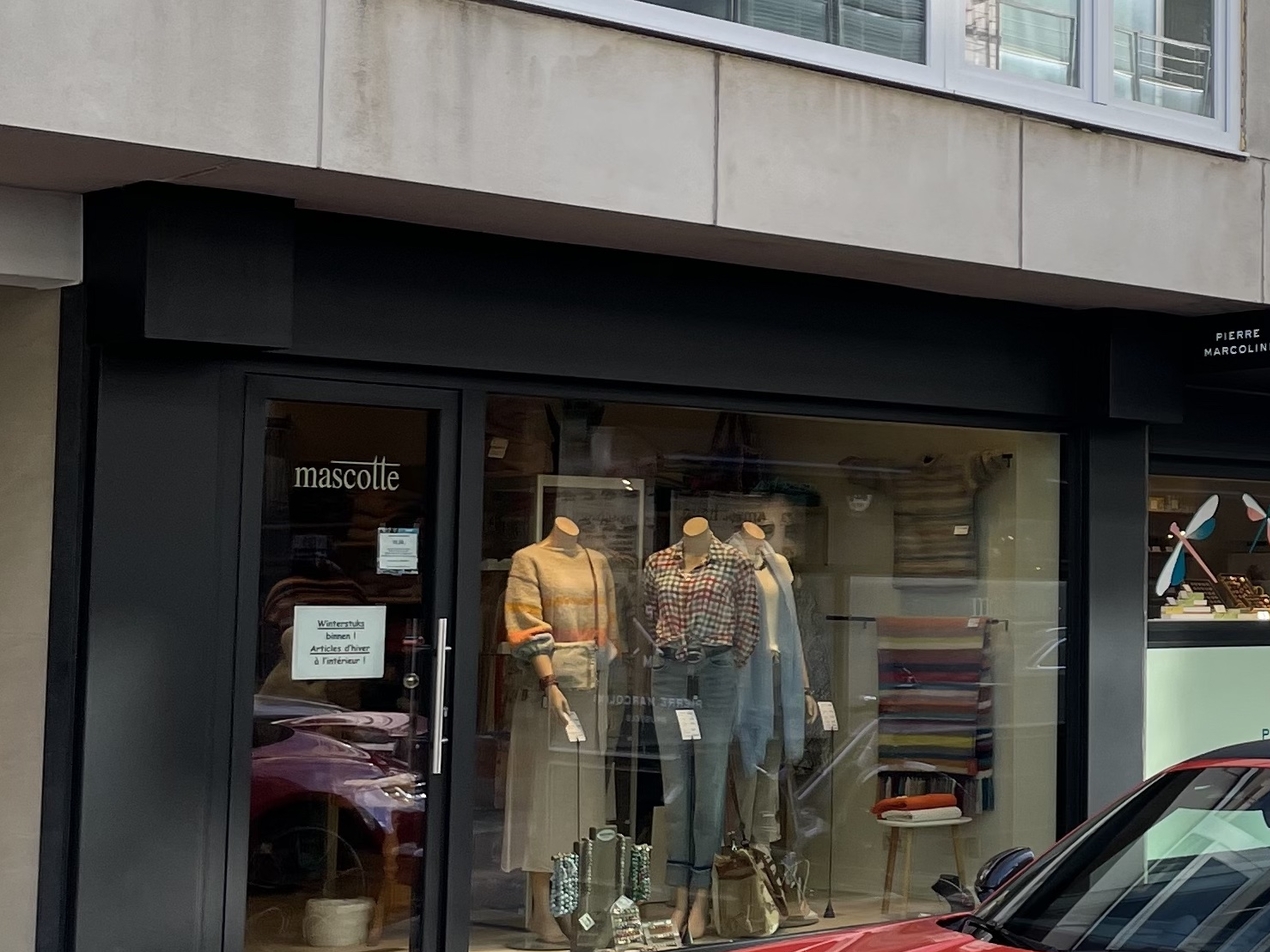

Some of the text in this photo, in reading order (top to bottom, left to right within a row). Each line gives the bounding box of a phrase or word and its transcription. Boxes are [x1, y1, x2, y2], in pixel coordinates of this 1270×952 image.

[1215, 328, 1260, 341] PIERRE
[293, 454, 400, 491] mascotte
[310, 643, 371, 653] Articles d'hiver
[322, 656, 360, 665] l'intérieur
